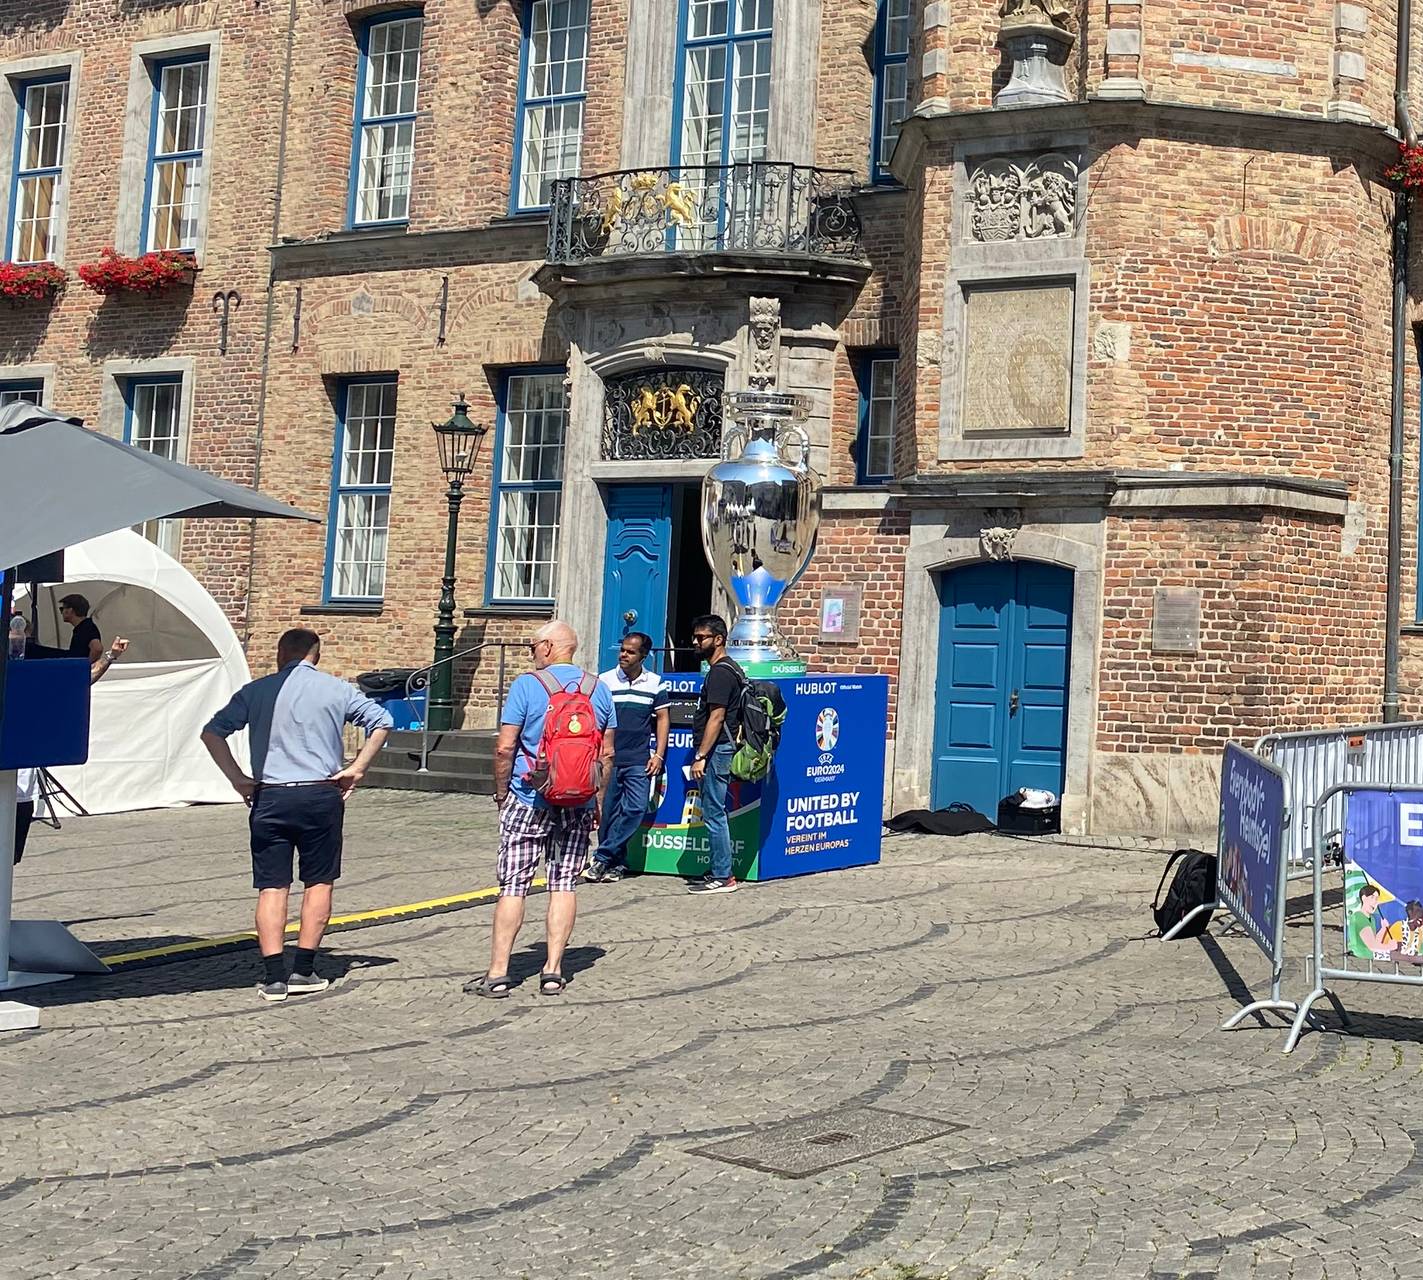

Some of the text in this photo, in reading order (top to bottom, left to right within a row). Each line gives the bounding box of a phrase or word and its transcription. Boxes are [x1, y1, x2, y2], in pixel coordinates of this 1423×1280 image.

[665, 681, 696, 692] BLOT
[795, 682, 837, 695] HUBLOT
[806, 764, 845, 777] EURO2024
[787, 791, 860, 814] UNITED BY
[786, 809, 858, 832] FOOTBALL
[642, 830, 745, 854] DÜSSELDRF
[786, 831, 827, 844] VEREINT IM
[1240, 811, 1271, 865] Heimspiel
[785, 839, 850, 856] HERZEN EUROPAS
